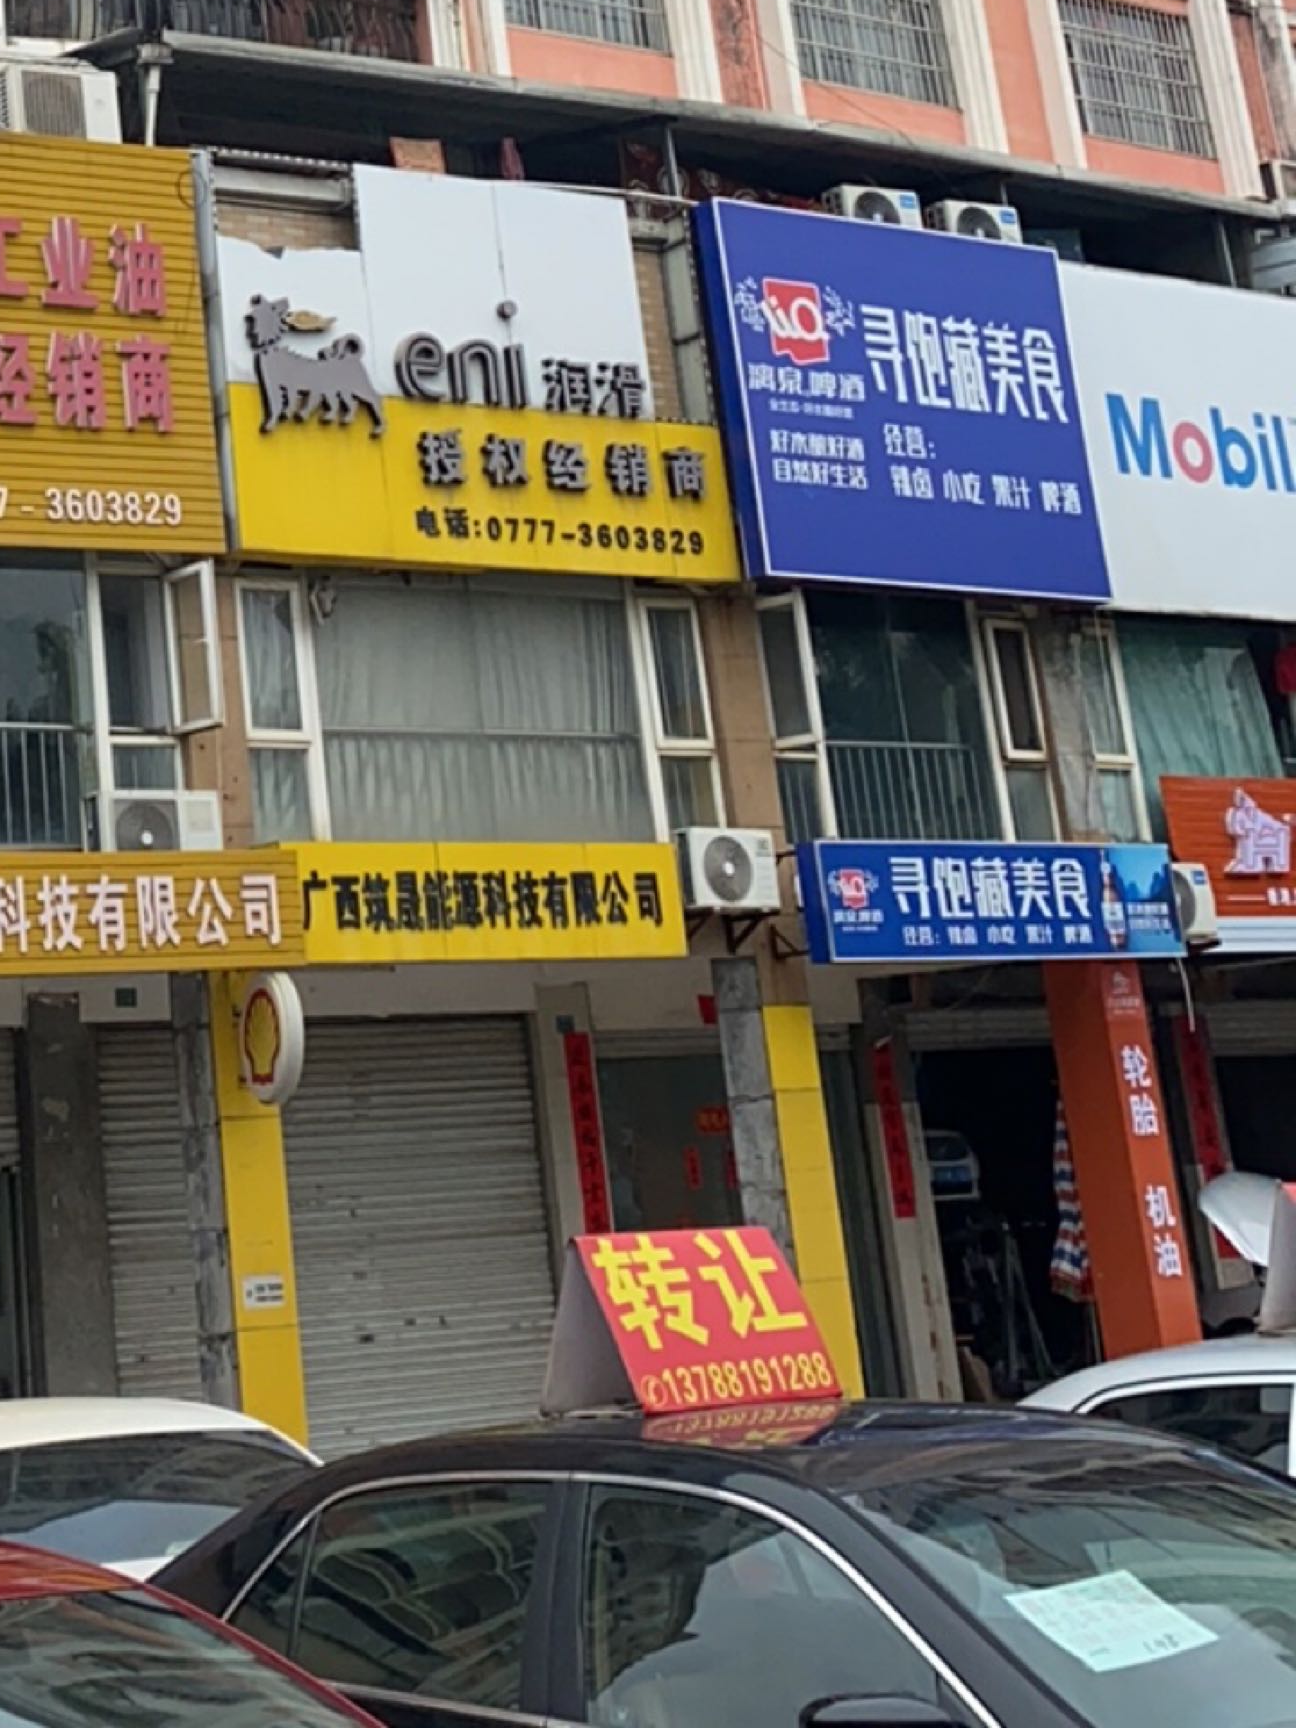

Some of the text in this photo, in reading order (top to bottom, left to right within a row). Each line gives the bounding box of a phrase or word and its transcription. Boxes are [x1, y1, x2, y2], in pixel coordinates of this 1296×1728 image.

[394, 299, 646, 420] eni 润滑
[416, 427, 707, 503] 授权经销商
[1105, 392, 1296, 493] Mobil
[303, 871, 664, 934] 广西筑晟能源科技有限公司
[1120, 1044, 1160, 1137] 轮胎
[1144, 1184, 1183, 1278] 机油
[592, 1229, 808, 1351] 转让
[661, 1351, 834, 1405] 13788191288
